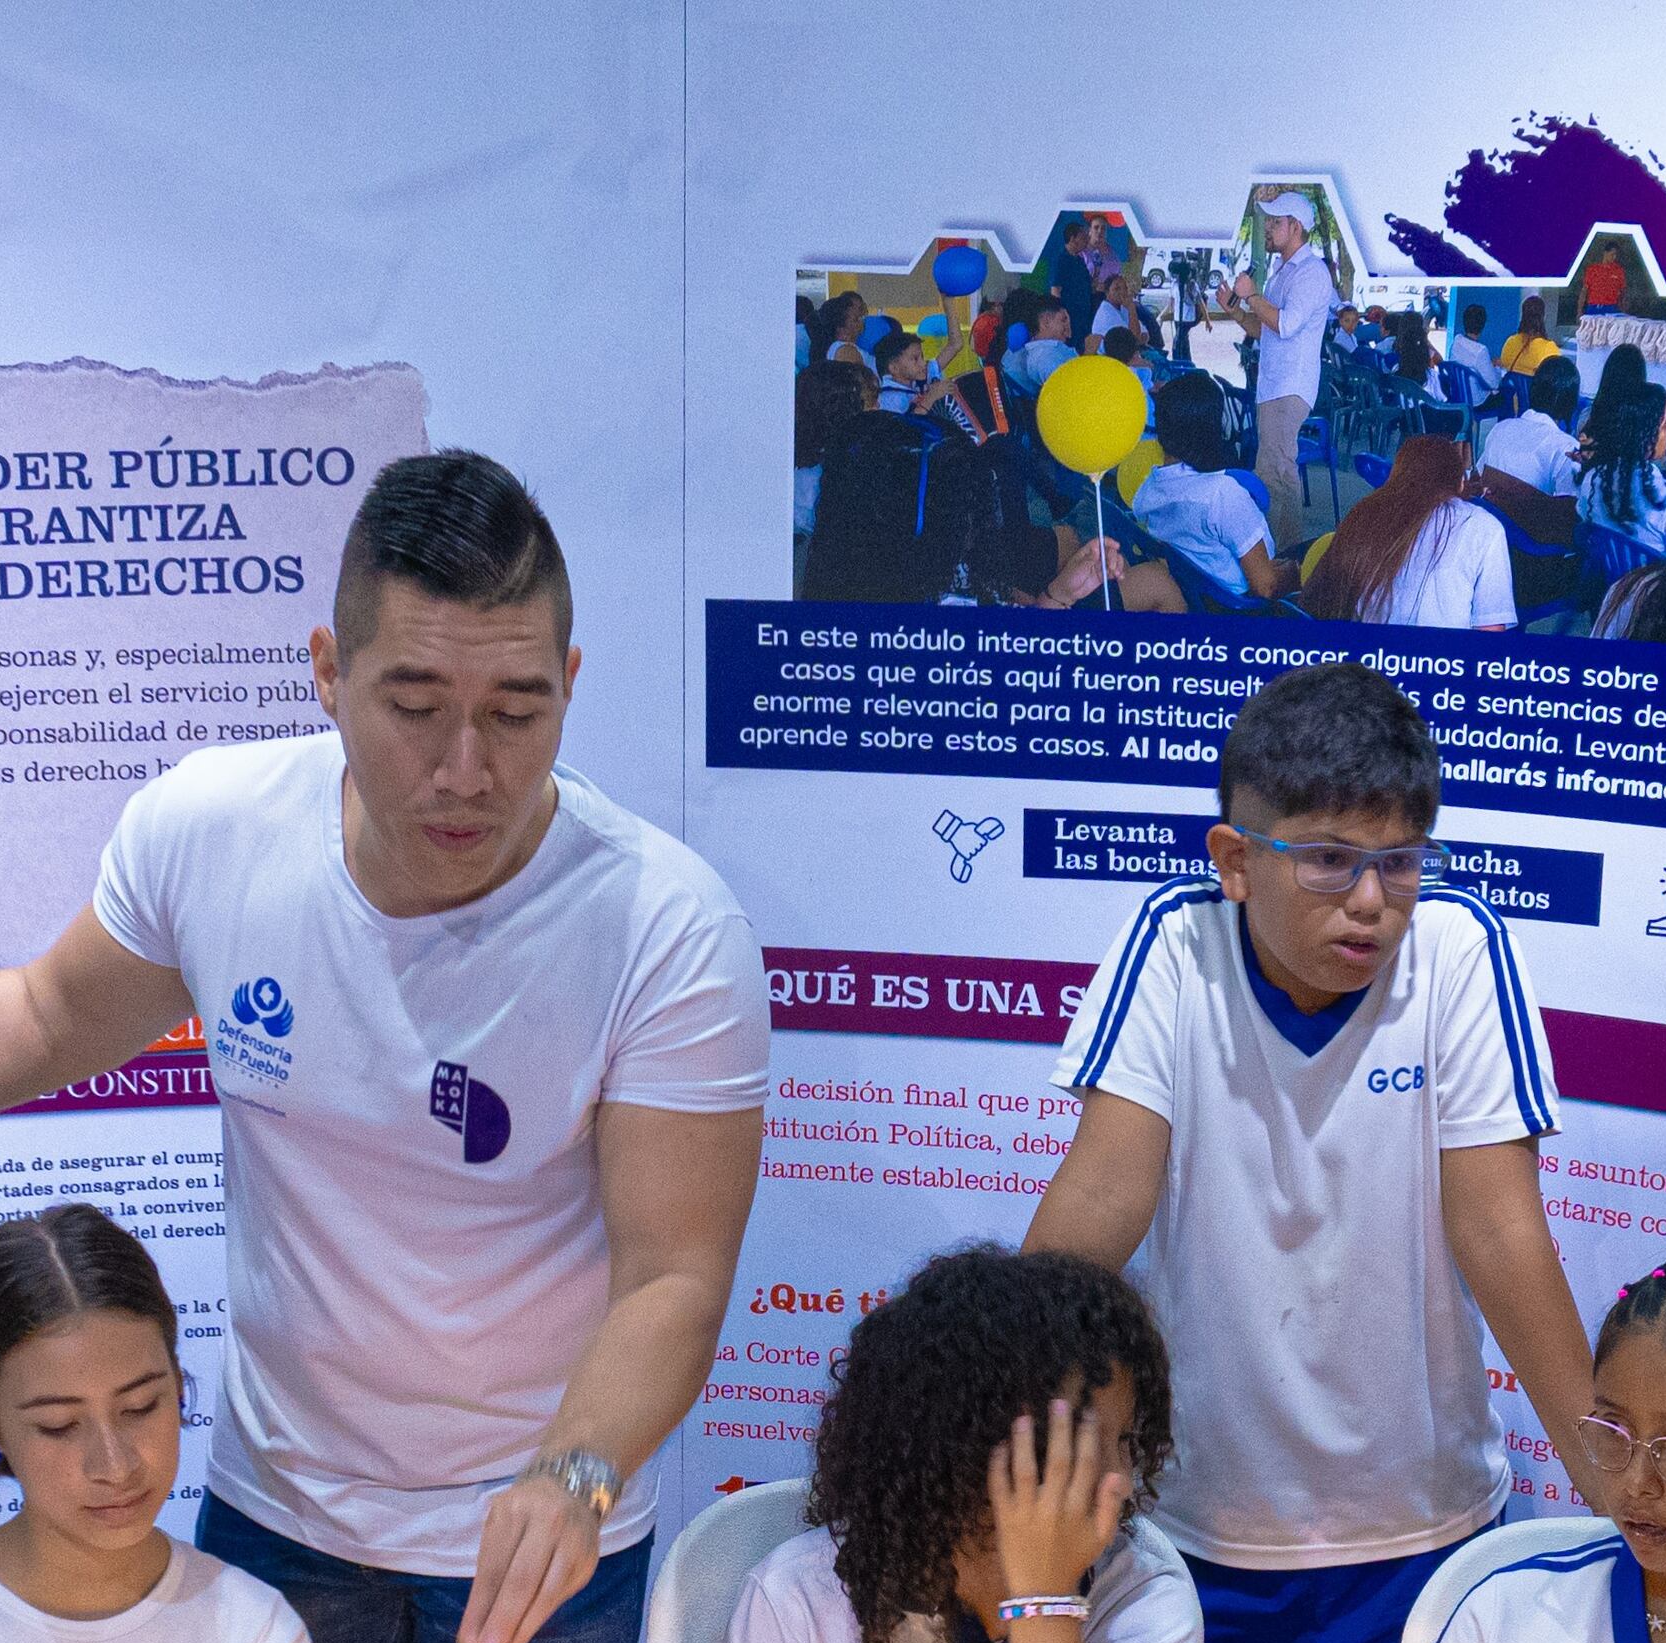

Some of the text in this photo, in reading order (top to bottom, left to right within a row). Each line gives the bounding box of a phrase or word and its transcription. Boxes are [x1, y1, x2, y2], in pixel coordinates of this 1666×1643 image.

[110, 437, 354, 488] PÚBLICO
[85, 650, 105, 671] y,
[115, 643, 310, 670] especialmente
[758, 624, 788, 645] En
[800, 627, 858, 648] este
[870, 626, 965, 651] módulo
[978, 631, 1123, 657] interactivo
[1136, 637, 1227, 663] podrás
[1240, 646, 1348, 666] conocer
[1360, 648, 1464, 676] algunos
[1477, 657, 1570, 684] relatos
[1583, 666, 1658, 691] sobre
[24, 760, 147, 782] derechos
[1439, 758, 1546, 787] hallarás
[1055, 818, 1175, 843] Levanta
[1055, 847, 1215, 879] las bocinas
[872, 975, 928, 1009] ES
[945, 979, 1044, 1015] UNA
[218, 1018, 293, 1064] Defensoría
[216, 1038, 289, 1081] del Pueblo
[1368, 1065, 1424, 1093] GCB
[779, 1077, 1028, 1116] decisión final que
[60, 1155, 146, 1172] asegurar
[59, 1177, 179, 1195] consagrados
[750, 1285, 844, 1313] ¿Qué
[705, 1383, 825, 1406] personas
